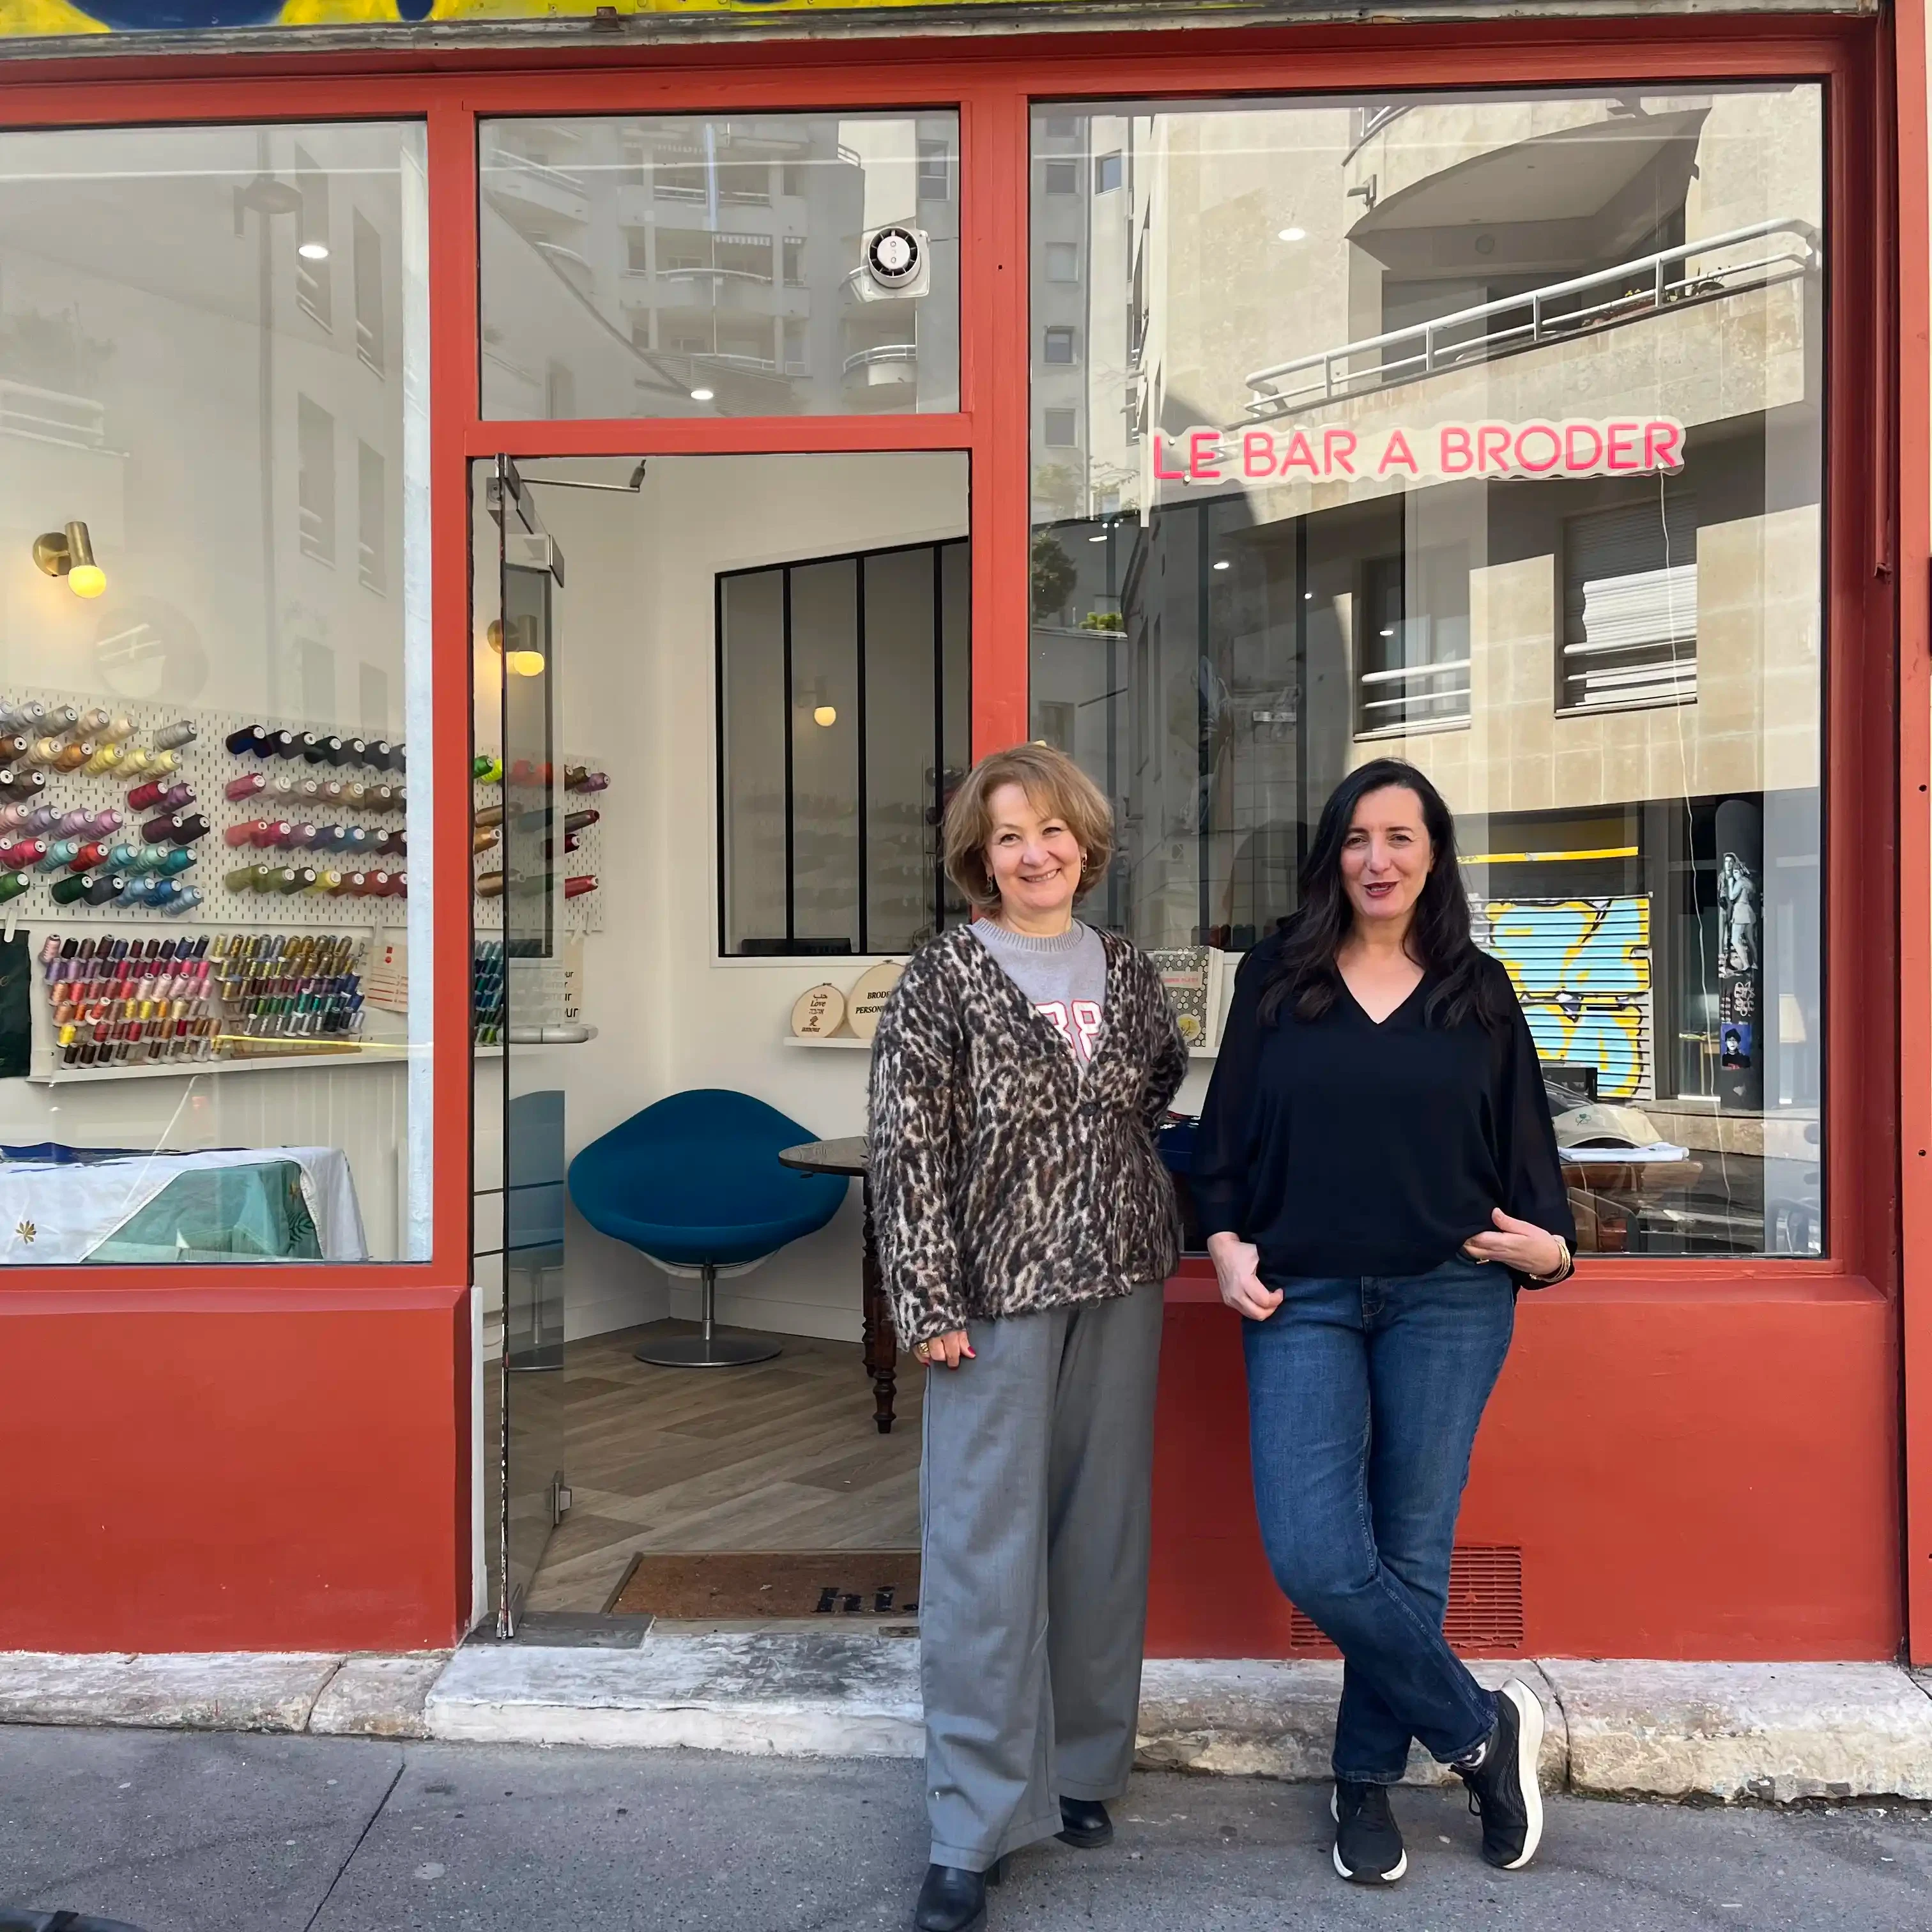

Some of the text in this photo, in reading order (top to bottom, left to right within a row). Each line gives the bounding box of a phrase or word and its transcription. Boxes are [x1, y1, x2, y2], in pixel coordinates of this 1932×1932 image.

[1153, 423, 1680, 479] LE BAR A BRODER
